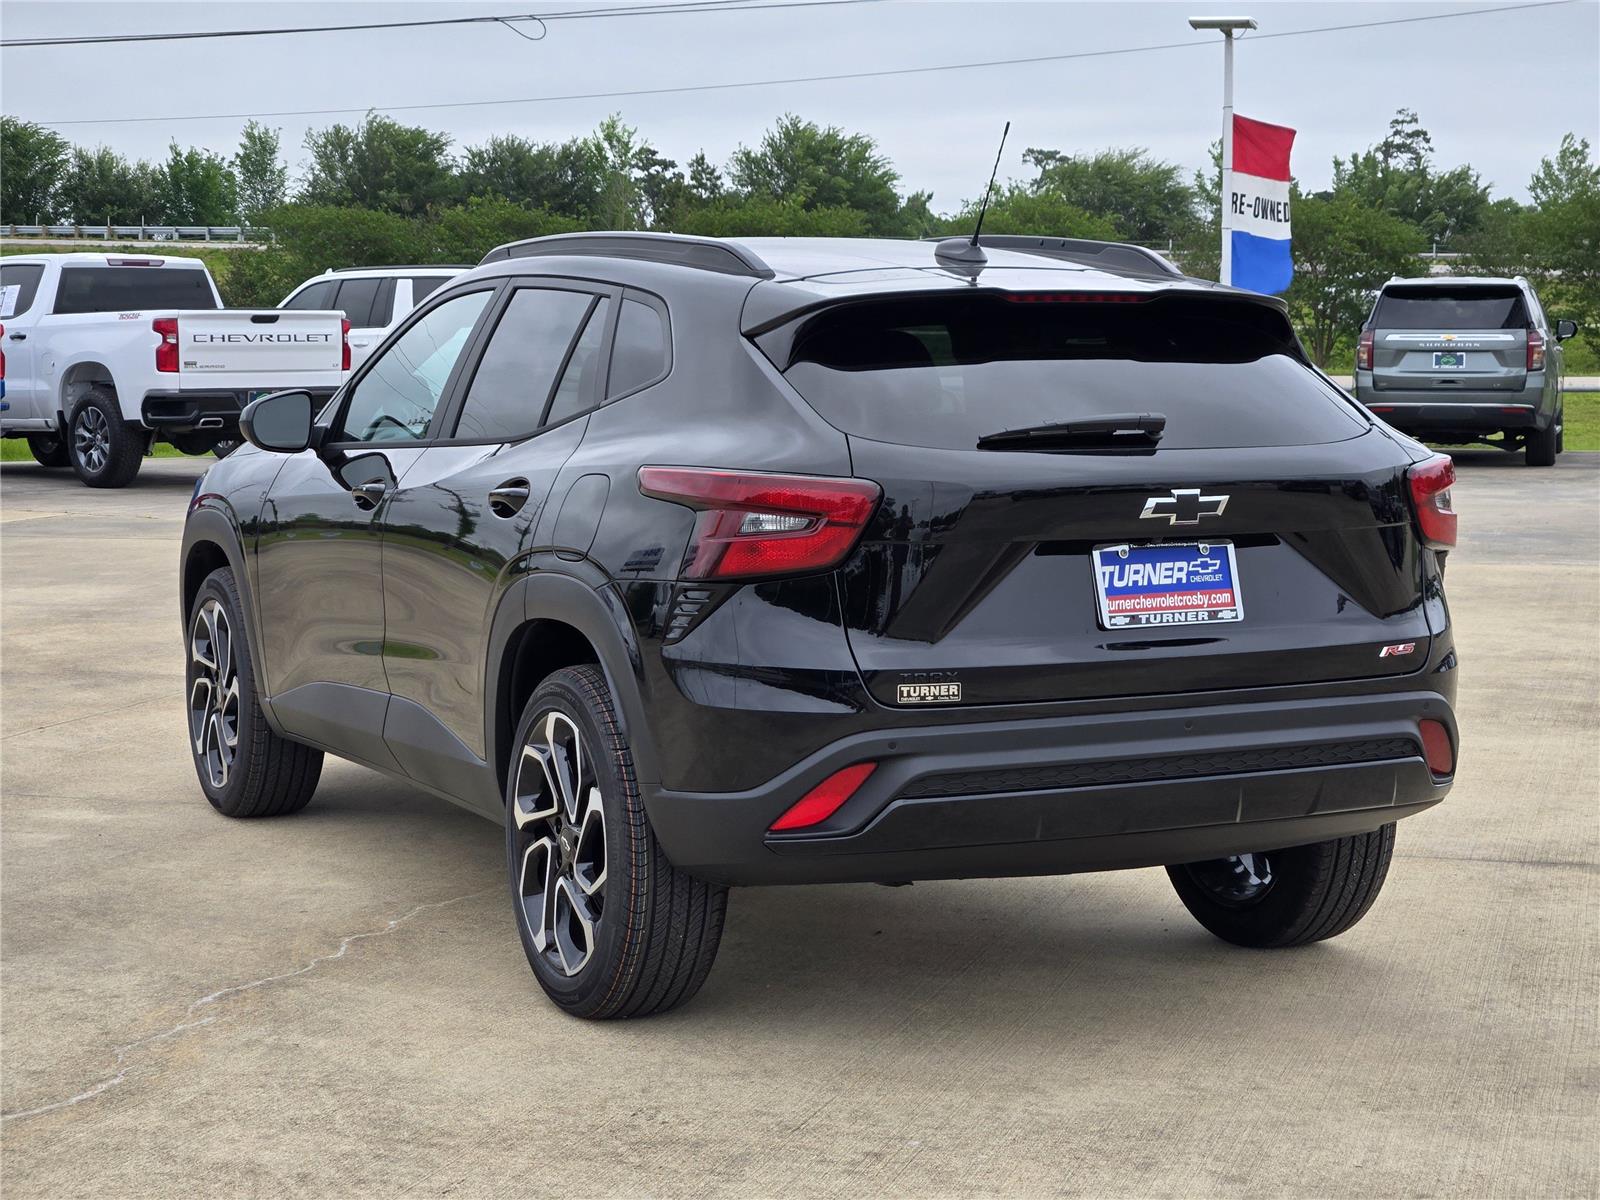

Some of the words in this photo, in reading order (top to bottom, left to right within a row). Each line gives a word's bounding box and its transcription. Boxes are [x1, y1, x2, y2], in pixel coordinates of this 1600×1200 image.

[1232, 192, 1290, 224] RE-OWNED
[193, 333, 333, 343] CHEVROLET
[1102, 560, 1188, 589] TURNER
[1190, 573, 1223, 583] CHEVROLET
[1106, 591, 1231, 611] turnerchevroletcrosby.com
[1139, 611, 1209, 624] TURNER
[1379, 642, 1416, 657] RS
[900, 685, 959, 697] TURNER
